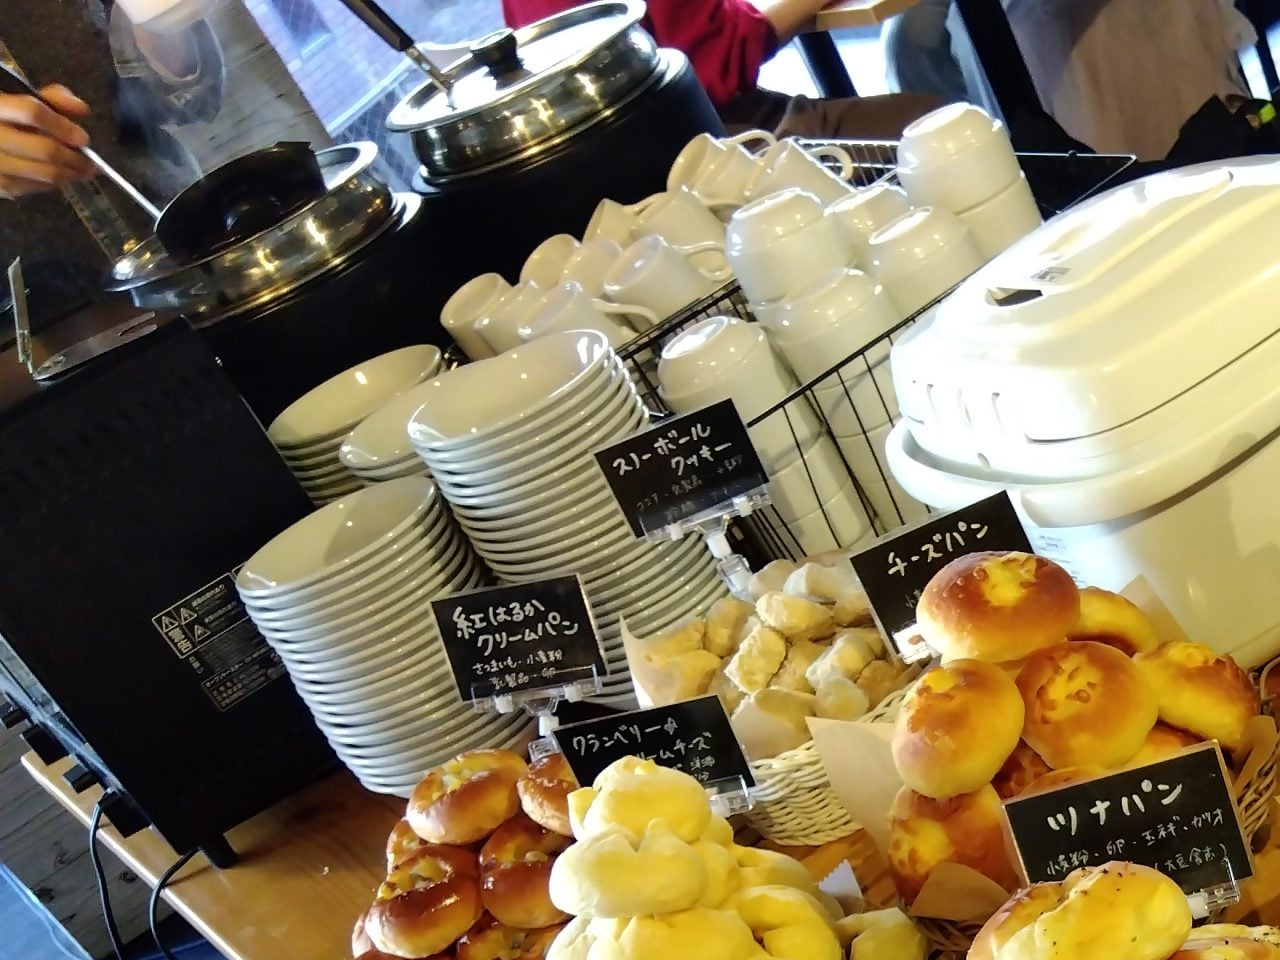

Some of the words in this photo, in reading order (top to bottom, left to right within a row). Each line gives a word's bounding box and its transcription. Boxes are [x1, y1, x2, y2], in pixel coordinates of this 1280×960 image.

[612, 423, 711, 476] スノーボール
[671, 442, 732, 476] クッキー
[887, 521, 989, 577] チーズパン
[452, 599, 546, 640] 紅はるか
[477, 611, 579, 656] クリームパン
[1047, 779, 1183, 835] ツナパン
